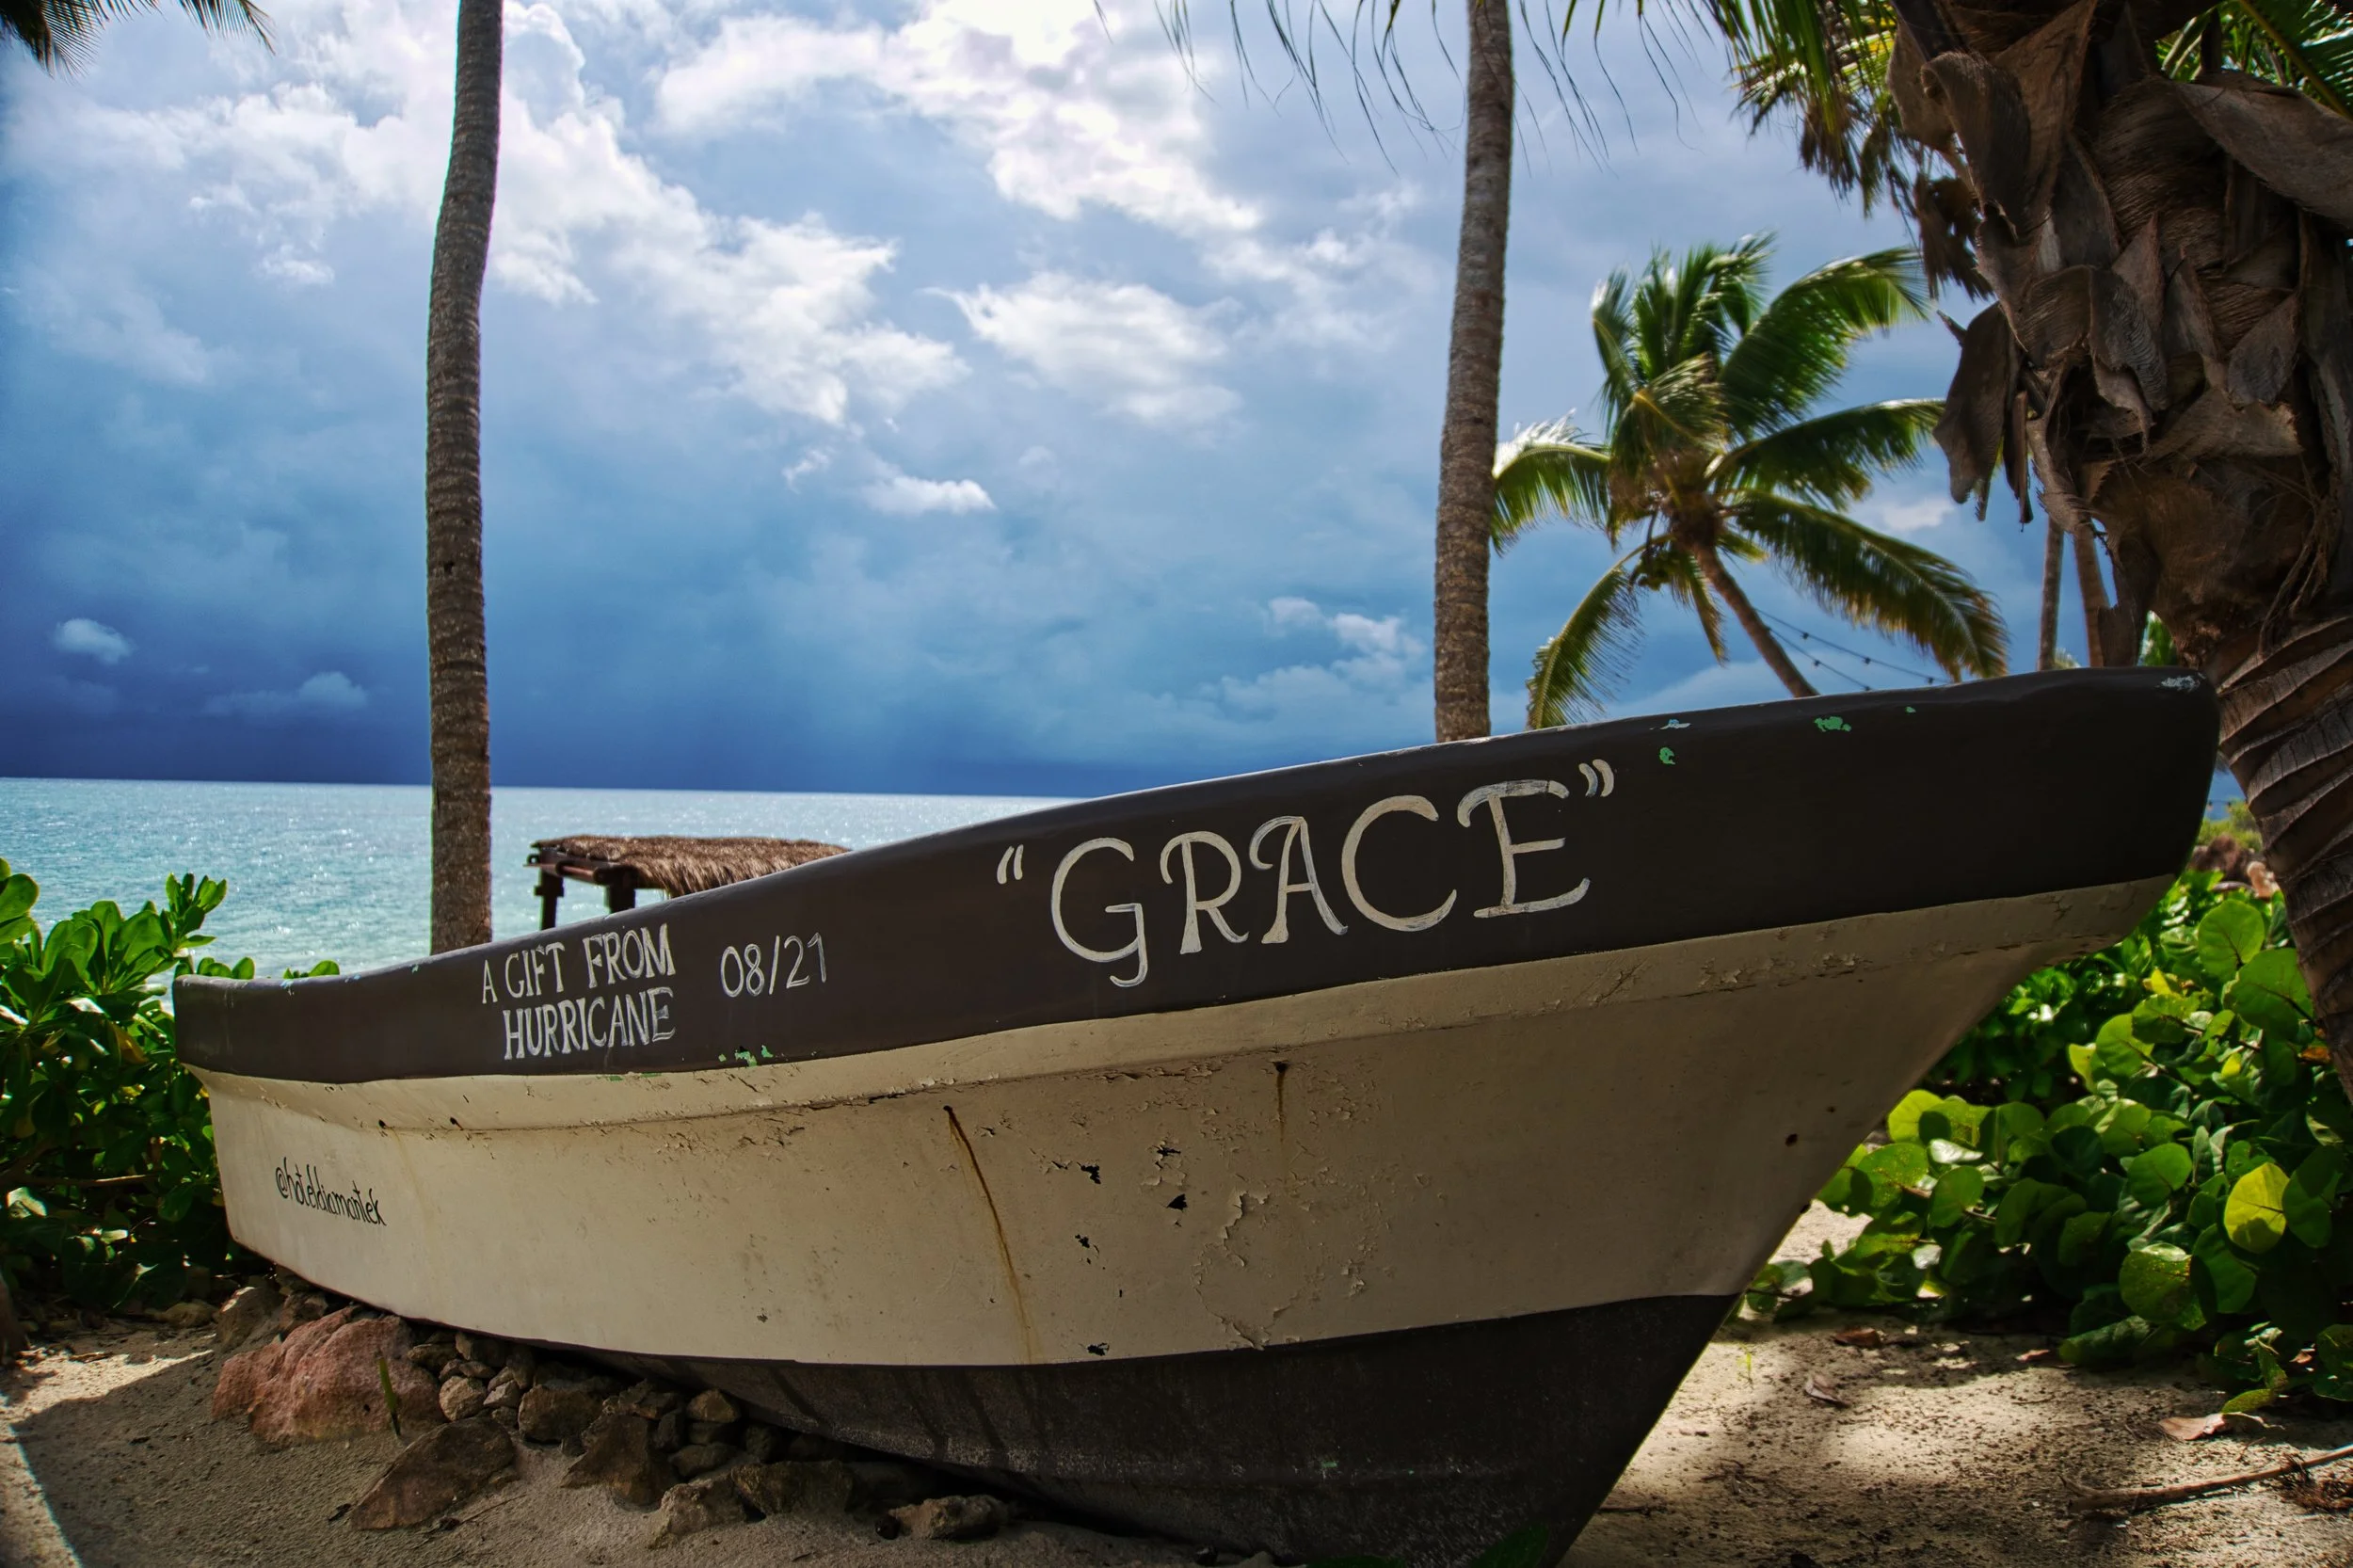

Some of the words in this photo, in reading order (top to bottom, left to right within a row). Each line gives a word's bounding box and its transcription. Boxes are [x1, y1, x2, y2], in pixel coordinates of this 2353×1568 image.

[482, 959, 499, 1004] A
[504, 941, 566, 999] GIFT
[582, 922, 677, 989] FROM
[719, 932, 827, 999] 08/21
[502, 986, 677, 1061] HURRICANE
